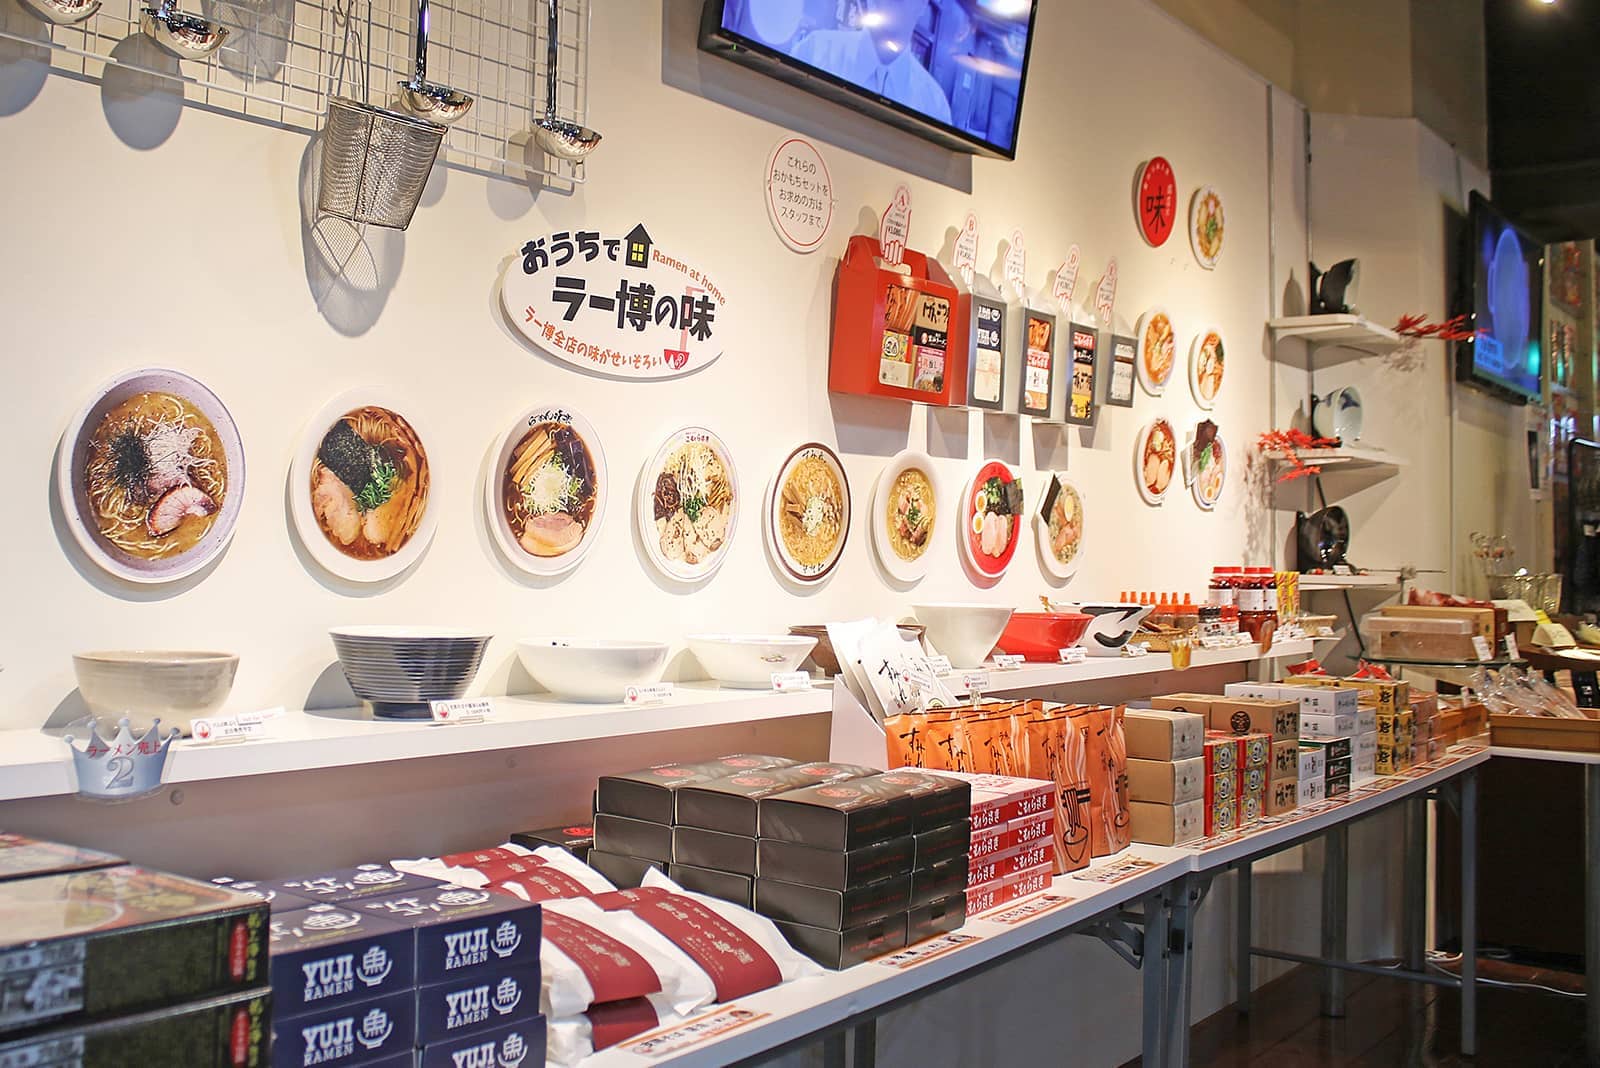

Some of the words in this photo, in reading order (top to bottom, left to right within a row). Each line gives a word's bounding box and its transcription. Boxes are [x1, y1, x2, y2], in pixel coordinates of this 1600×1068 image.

[787, 156, 816, 175] これらの
[773, 169, 829, 197] おかもちセットを
[779, 188, 823, 212] お求めの方は
[1145, 184, 1166, 234] 味
[521, 231, 620, 275] おうちで
[652, 249, 688, 274] Ramen
[689, 269, 701, 282] at
[701, 275, 726, 306] home
[552, 276, 716, 341] ラー博の味
[86, 741, 162, 760] ラーメン売上
[105, 756, 135, 790] 2
[1017, 794, 1047, 816] こむらさき
[1017, 821, 1046, 843] こむらさき
[1013, 848, 1045, 870] こむらさき
[1012, 874, 1044, 897] こむらさき
[444, 928, 489, 958] YUJI
[302, 954, 354, 989] YUJI
[445, 951, 489, 970] RAMEN
[304, 980, 354, 1002] RAMEN
[445, 986, 490, 1016] YUJI
[447, 1009, 489, 1029] RAMEN
[302, 1017, 355, 1052] YUJI
[304, 1045, 354, 1067] RAMEN
[452, 1041, 496, 1068] YUJI
